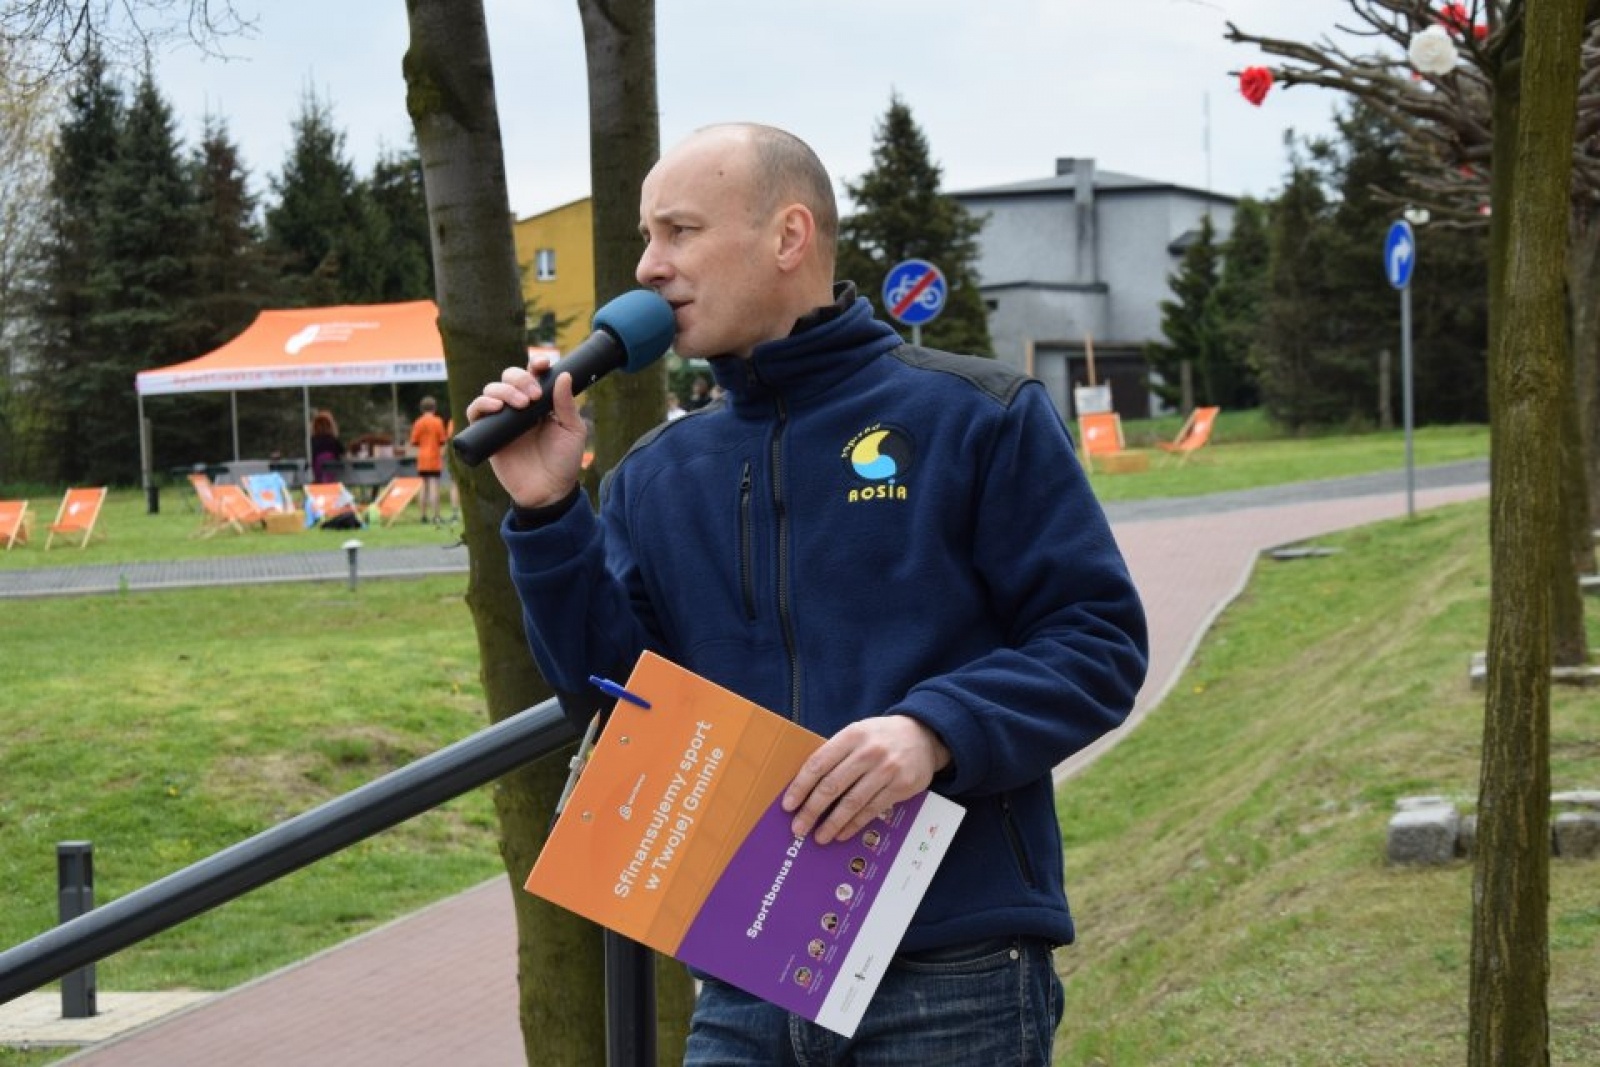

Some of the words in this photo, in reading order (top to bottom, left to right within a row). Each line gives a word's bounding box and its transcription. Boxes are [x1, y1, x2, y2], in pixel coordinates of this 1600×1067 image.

[614, 772, 687, 898] Sfinansujemy
[679, 720, 713, 771] sport
[645, 873, 661, 890] w
[653, 812, 694, 870] Twojej
[683, 747, 724, 810] Gminie
[747, 858, 792, 939] Sportbonus
